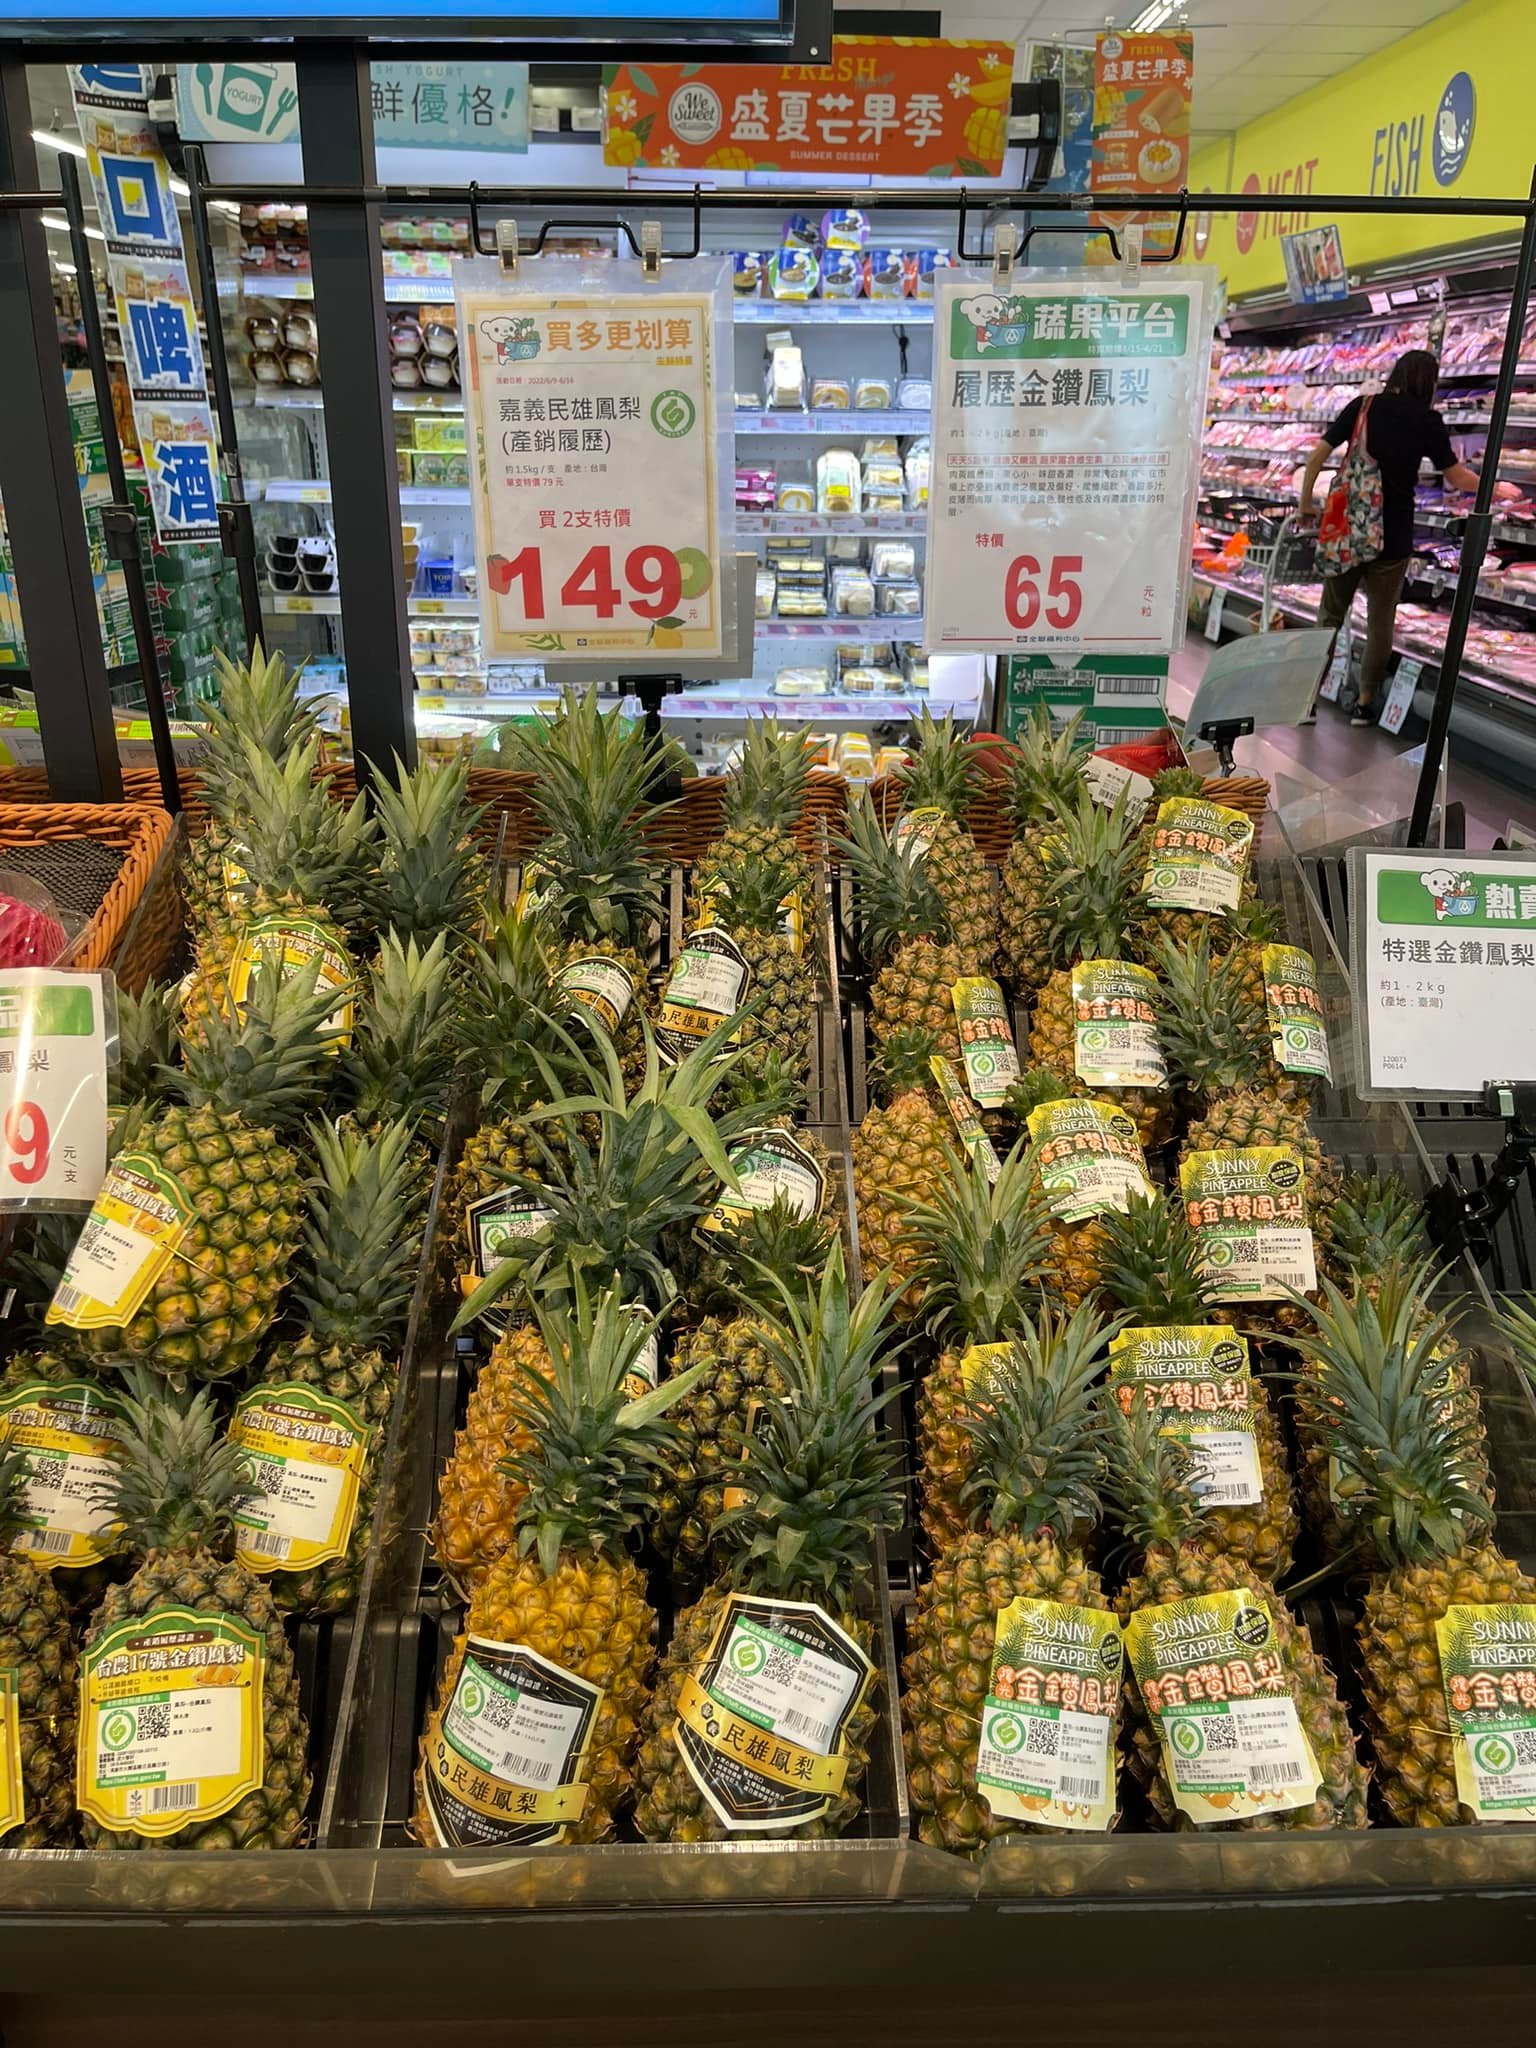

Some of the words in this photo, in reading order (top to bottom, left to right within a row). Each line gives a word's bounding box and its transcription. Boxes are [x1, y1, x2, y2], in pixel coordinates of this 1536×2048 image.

[1103, 59, 1187, 82] 盛夏芒果季
[226, 87, 263, 105] YOGURT
[684, 92, 709, 107] We
[674, 103, 715, 121] Sweet
[730, 89, 944, 148] 盛夏芒果季
[790, 150, 833, 161] SUMMER
[836, 152, 881, 162] DESSERT
[1369, 114, 1424, 196] FISH
[1263, 158, 1318, 240] MEAT
[1033, 303, 1176, 340] 蔬果平台
[546, 319, 693, 351] 買多更划算
[952, 368, 1149, 408] 履歷金鑽鳳梨
[498, 396, 641, 422] 嘉義民雄鳳梨
[501, 429, 612, 455] (產銷履歷)
[543, 478, 554, 487] 79
[539, 510, 557, 528] 買
[975, 533, 1004, 548] 特價
[502, 545, 682, 620] 149
[1004, 554, 1083, 630] 65
[688, 609, 698, 619] 元
[1173, 817, 1226, 834] PINEAPPLE
[1181, 805, 1224, 821] SUNNY
[1382, 938, 1536, 967] 特選金鑽鳳梨
[1052, 1106, 1100, 1119] SUNNY
[5, 1101, 50, 1184] 9
[1205, 1159, 1260, 1176] SUNNY
[1202, 1178, 1268, 1192] PINEAPPLE
[1199, 1192, 1304, 1223] 金鑽鳳梨
[1140, 1339, 1201, 1356] SUNNY
[1136, 1360, 1209, 1377] PINEAPPLE
[1034, 1617, 1096, 1643] SUNNY
[1153, 1611, 1221, 1641] SUNNY
[97, 1644, 245, 1679] 台農17號金鑽鳳梨
[1023, 1643, 1098, 1668] PINEAPPLE
[1156, 1635, 1235, 1666] PINEAPPLE
[1015, 1666, 1119, 1717] 金鑽鳳梨
[1158, 1651, 1285, 1706] 金鑽鳳梨
[723, 1723, 815, 1782] 民雄鳳梨
[450, 1763, 538, 1815] 民雄鳳梨
